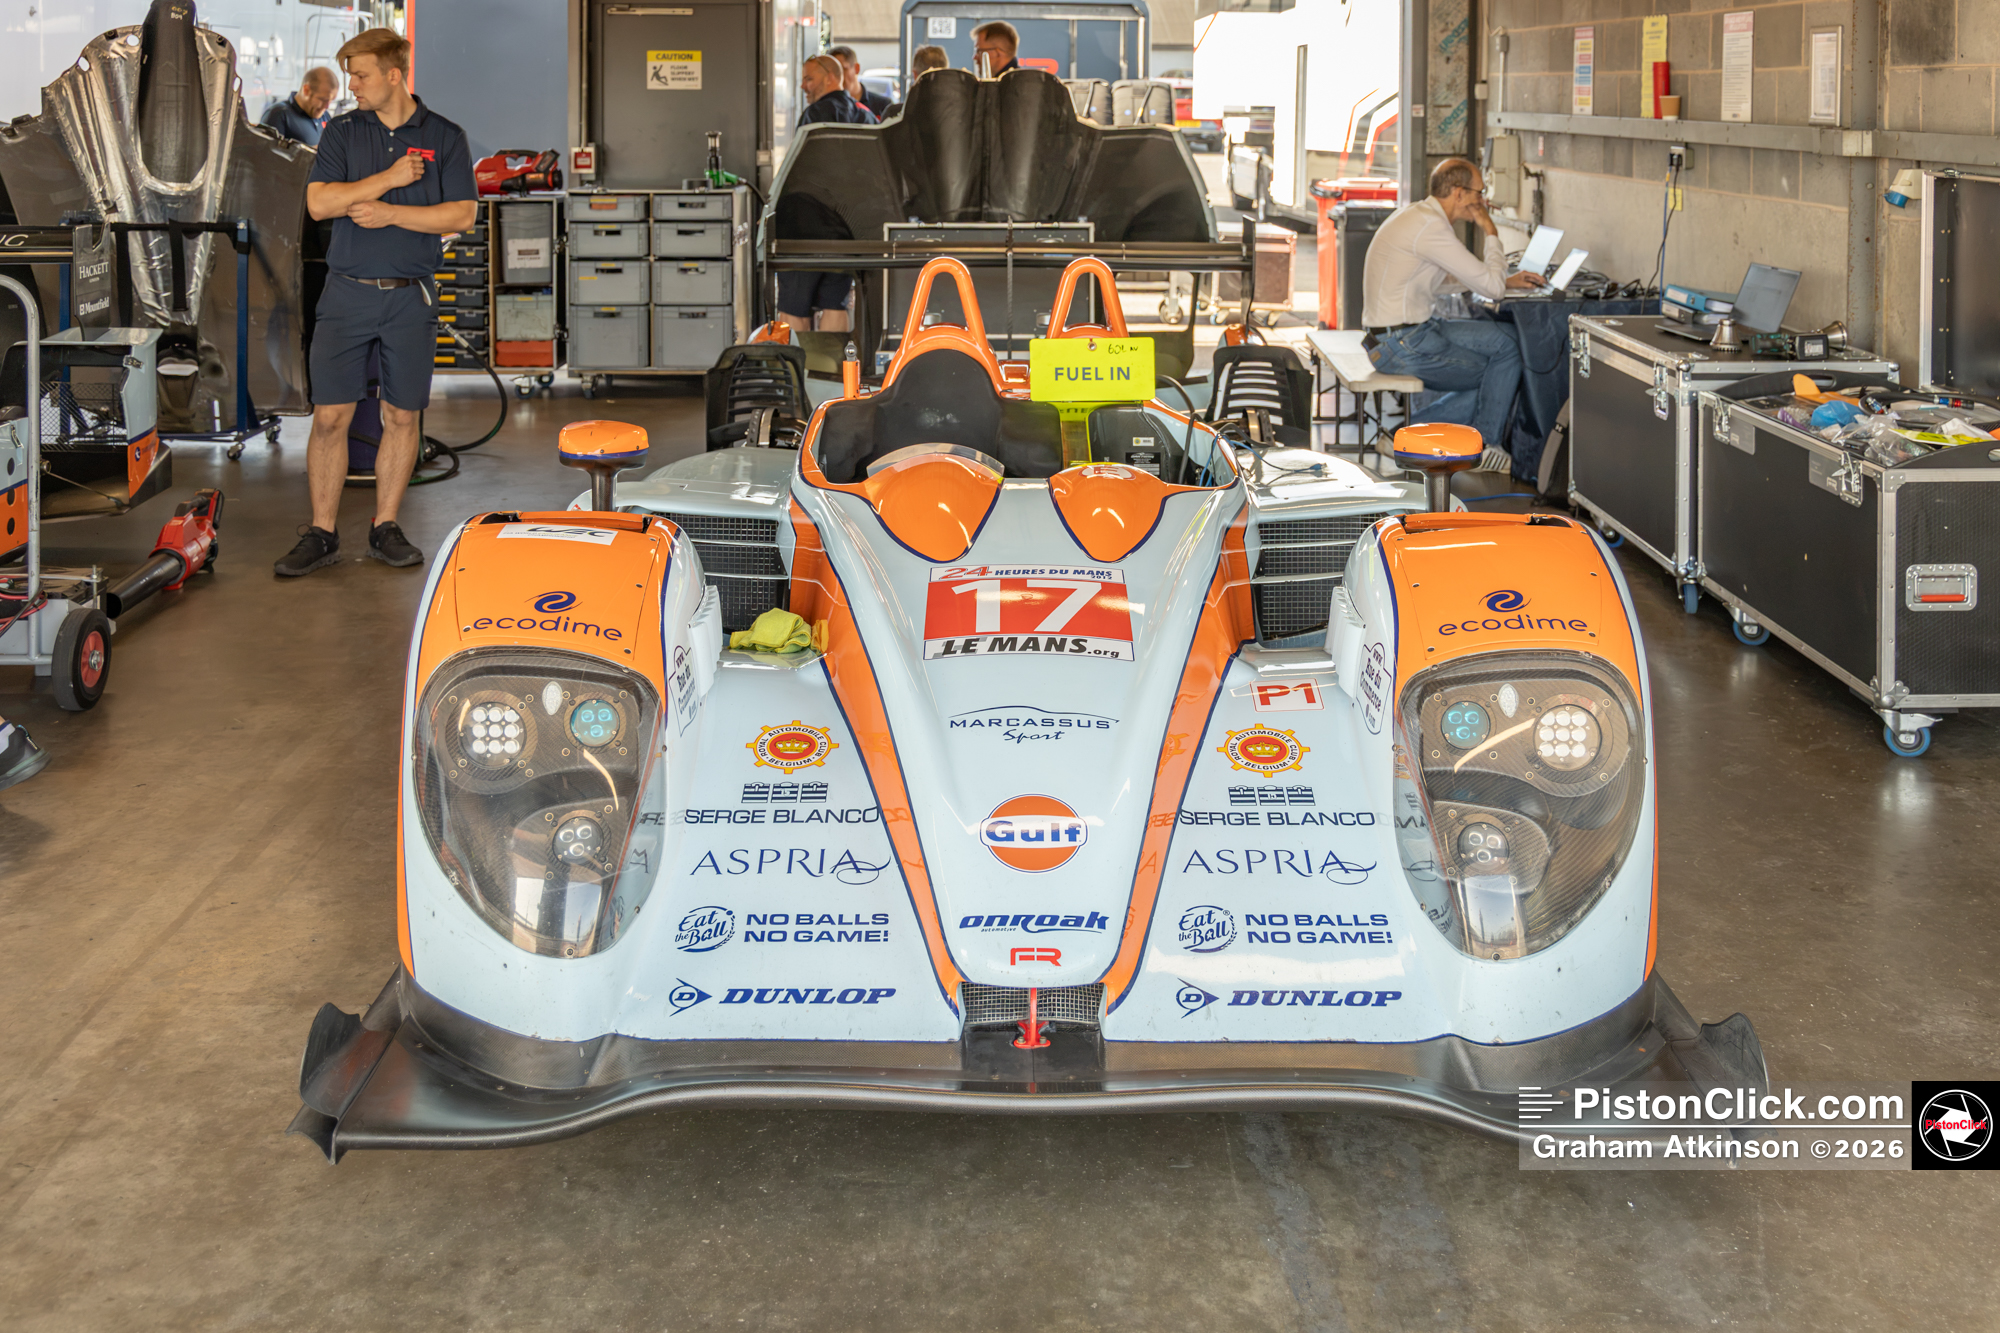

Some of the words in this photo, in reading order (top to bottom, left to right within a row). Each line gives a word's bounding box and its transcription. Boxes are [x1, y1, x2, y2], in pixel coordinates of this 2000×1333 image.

[656, 52, 693, 60] CAUTION
[79, 261, 109, 279] HACKETT
[84, 296, 110, 314] Mountfield
[1054, 366, 1104, 381] FUEL
[1110, 366, 1130, 380] IN
[527, 526, 614, 538] WEC
[939, 566, 992, 580] 24
[995, 568, 1045, 576] HEURES
[1072, 569, 1112, 577] MANS
[952, 579, 1102, 633] 17
[473, 615, 623, 641] ecodime
[1438, 614, 1588, 636] ecodime
[942, 637, 980, 656] LE
[987, 636, 1120, 658] MANS.org
[1256, 682, 1316, 706] P1
[1360, 670, 1382, 712] Commerce
[950, 718, 1110, 729] MARCASSUS
[758, 738, 768, 757] ROYAL
[768, 726, 824, 740] AUTOMOBILE
[814, 742, 826, 758] CLUB
[1002, 729, 1066, 744] Sport
[1235, 730, 1292, 744] AUTOMOBILE
[1229, 742, 1242, 760] ROYAL
[1289, 744, 1298, 761] CLUB
[768, 758, 812, 766] BELGIUM
[1244, 761, 1289, 770] BELGIUM
[684, 809, 766, 824] SERGE
[772, 806, 880, 824] BLANCO
[1179, 809, 1262, 826] SERGE
[1267, 812, 1376, 826] BLANCO
[986, 820, 1082, 842] Gulf
[690, 849, 891, 885] ASPRIA
[1182, 849, 1376, 885] ASPRIA
[678, 910, 718, 932] Eat
[746, 914, 790, 926] NO
[795, 914, 890, 926] BALLS
[959, 911, 1110, 933] onroak
[1178, 910, 1216, 932] Eat
[1245, 914, 1289, 926] NO
[1294, 914, 1389, 926] BALLS
[675, 932, 689, 943] the
[688, 918, 728, 946] Ball
[744, 930, 788, 942] NO
[793, 930, 889, 942] GAME!
[1178, 932, 1192, 942] the
[1192, 920, 1230, 946] Ball
[1247, 932, 1291, 944] NO
[1297, 932, 1393, 944] GAME!
[1010, 948, 1062, 966] FR
[674, 992, 695, 1001] D
[718, 988, 896, 1004] DUNLOP
[1182, 994, 1202, 1002] D
[1227, 990, 1402, 1006] DUNLOP
